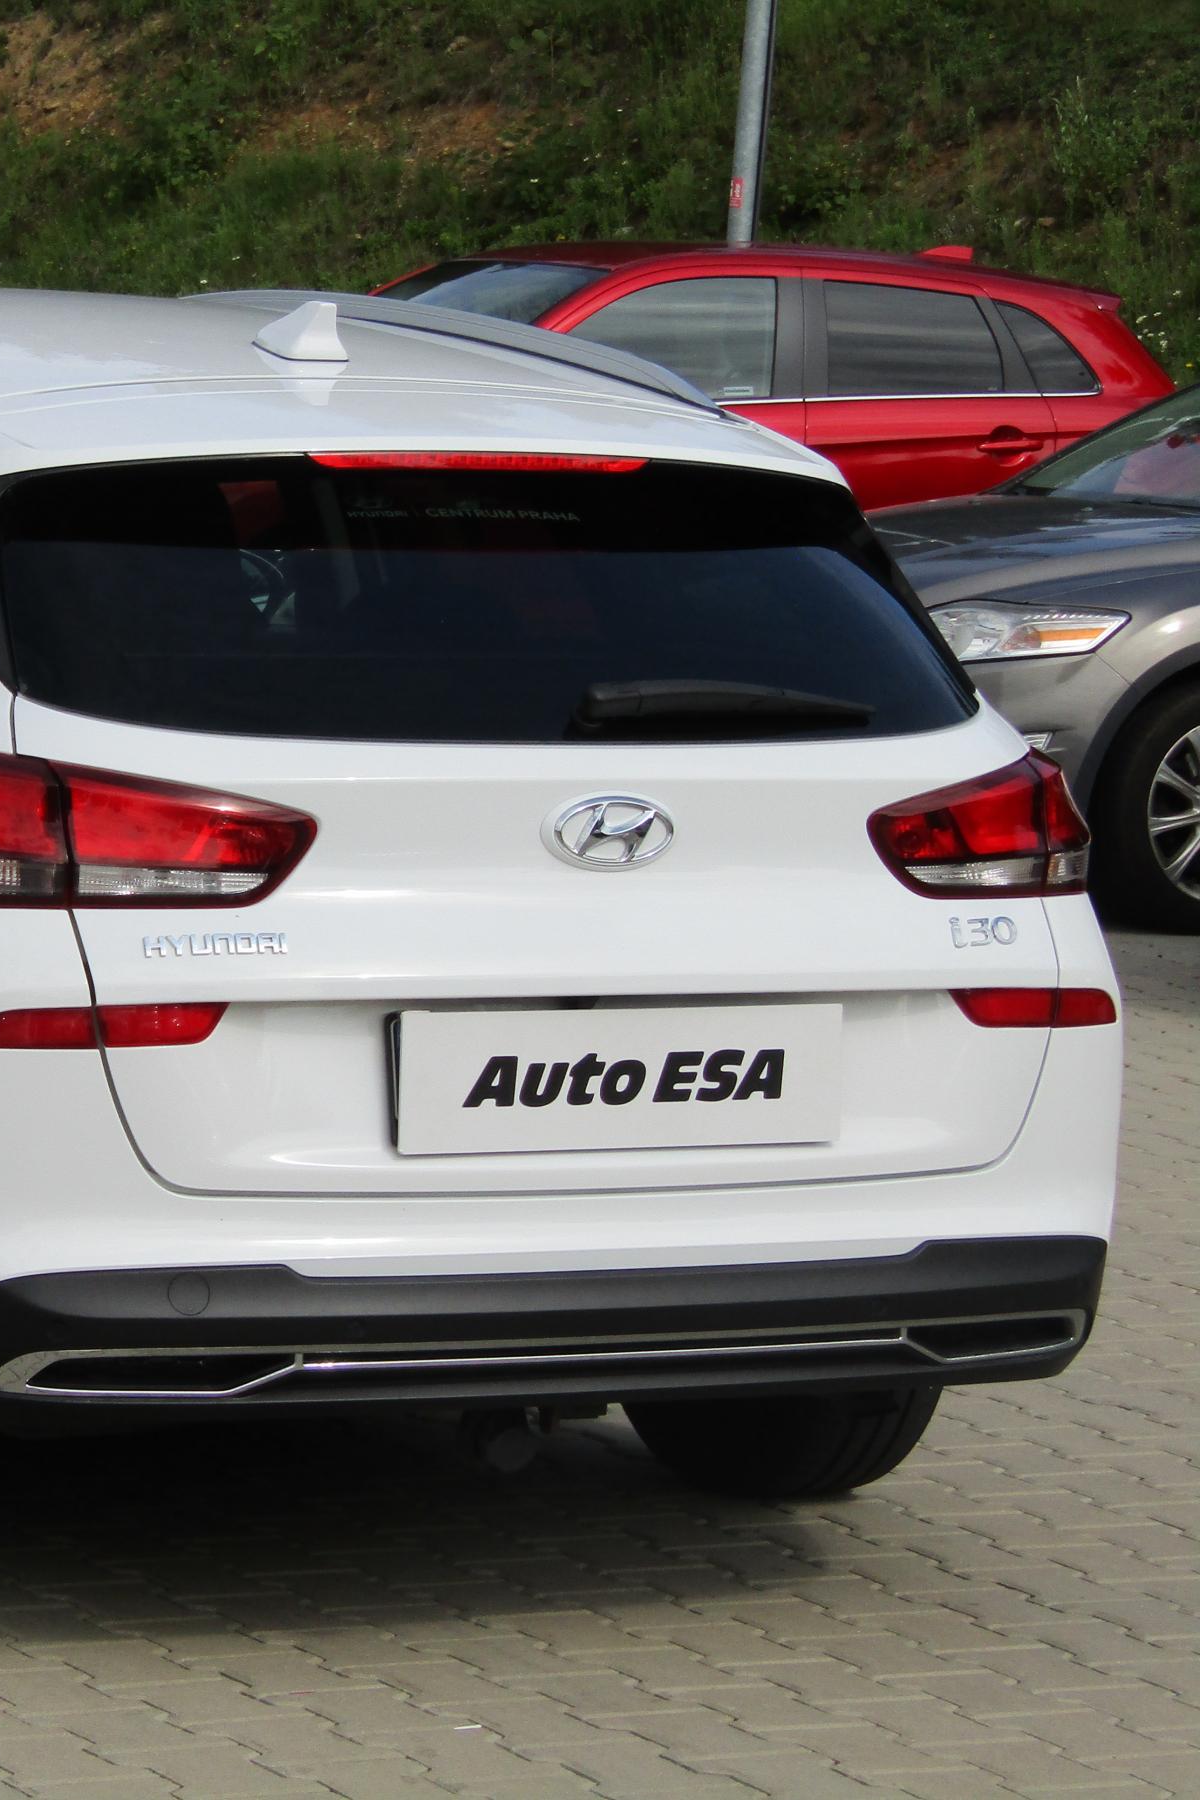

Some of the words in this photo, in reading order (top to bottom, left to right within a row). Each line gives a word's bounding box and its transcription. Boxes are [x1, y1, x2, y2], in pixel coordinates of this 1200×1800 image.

[424, 507, 516, 519] CENTRUM
[517, 509, 581, 522] PRAHA
[143, 932, 288, 958] HYUNDAI
[948, 916, 1018, 949] i30
[462, 1052, 646, 1107] Auto
[653, 1048, 786, 1102] ESA
